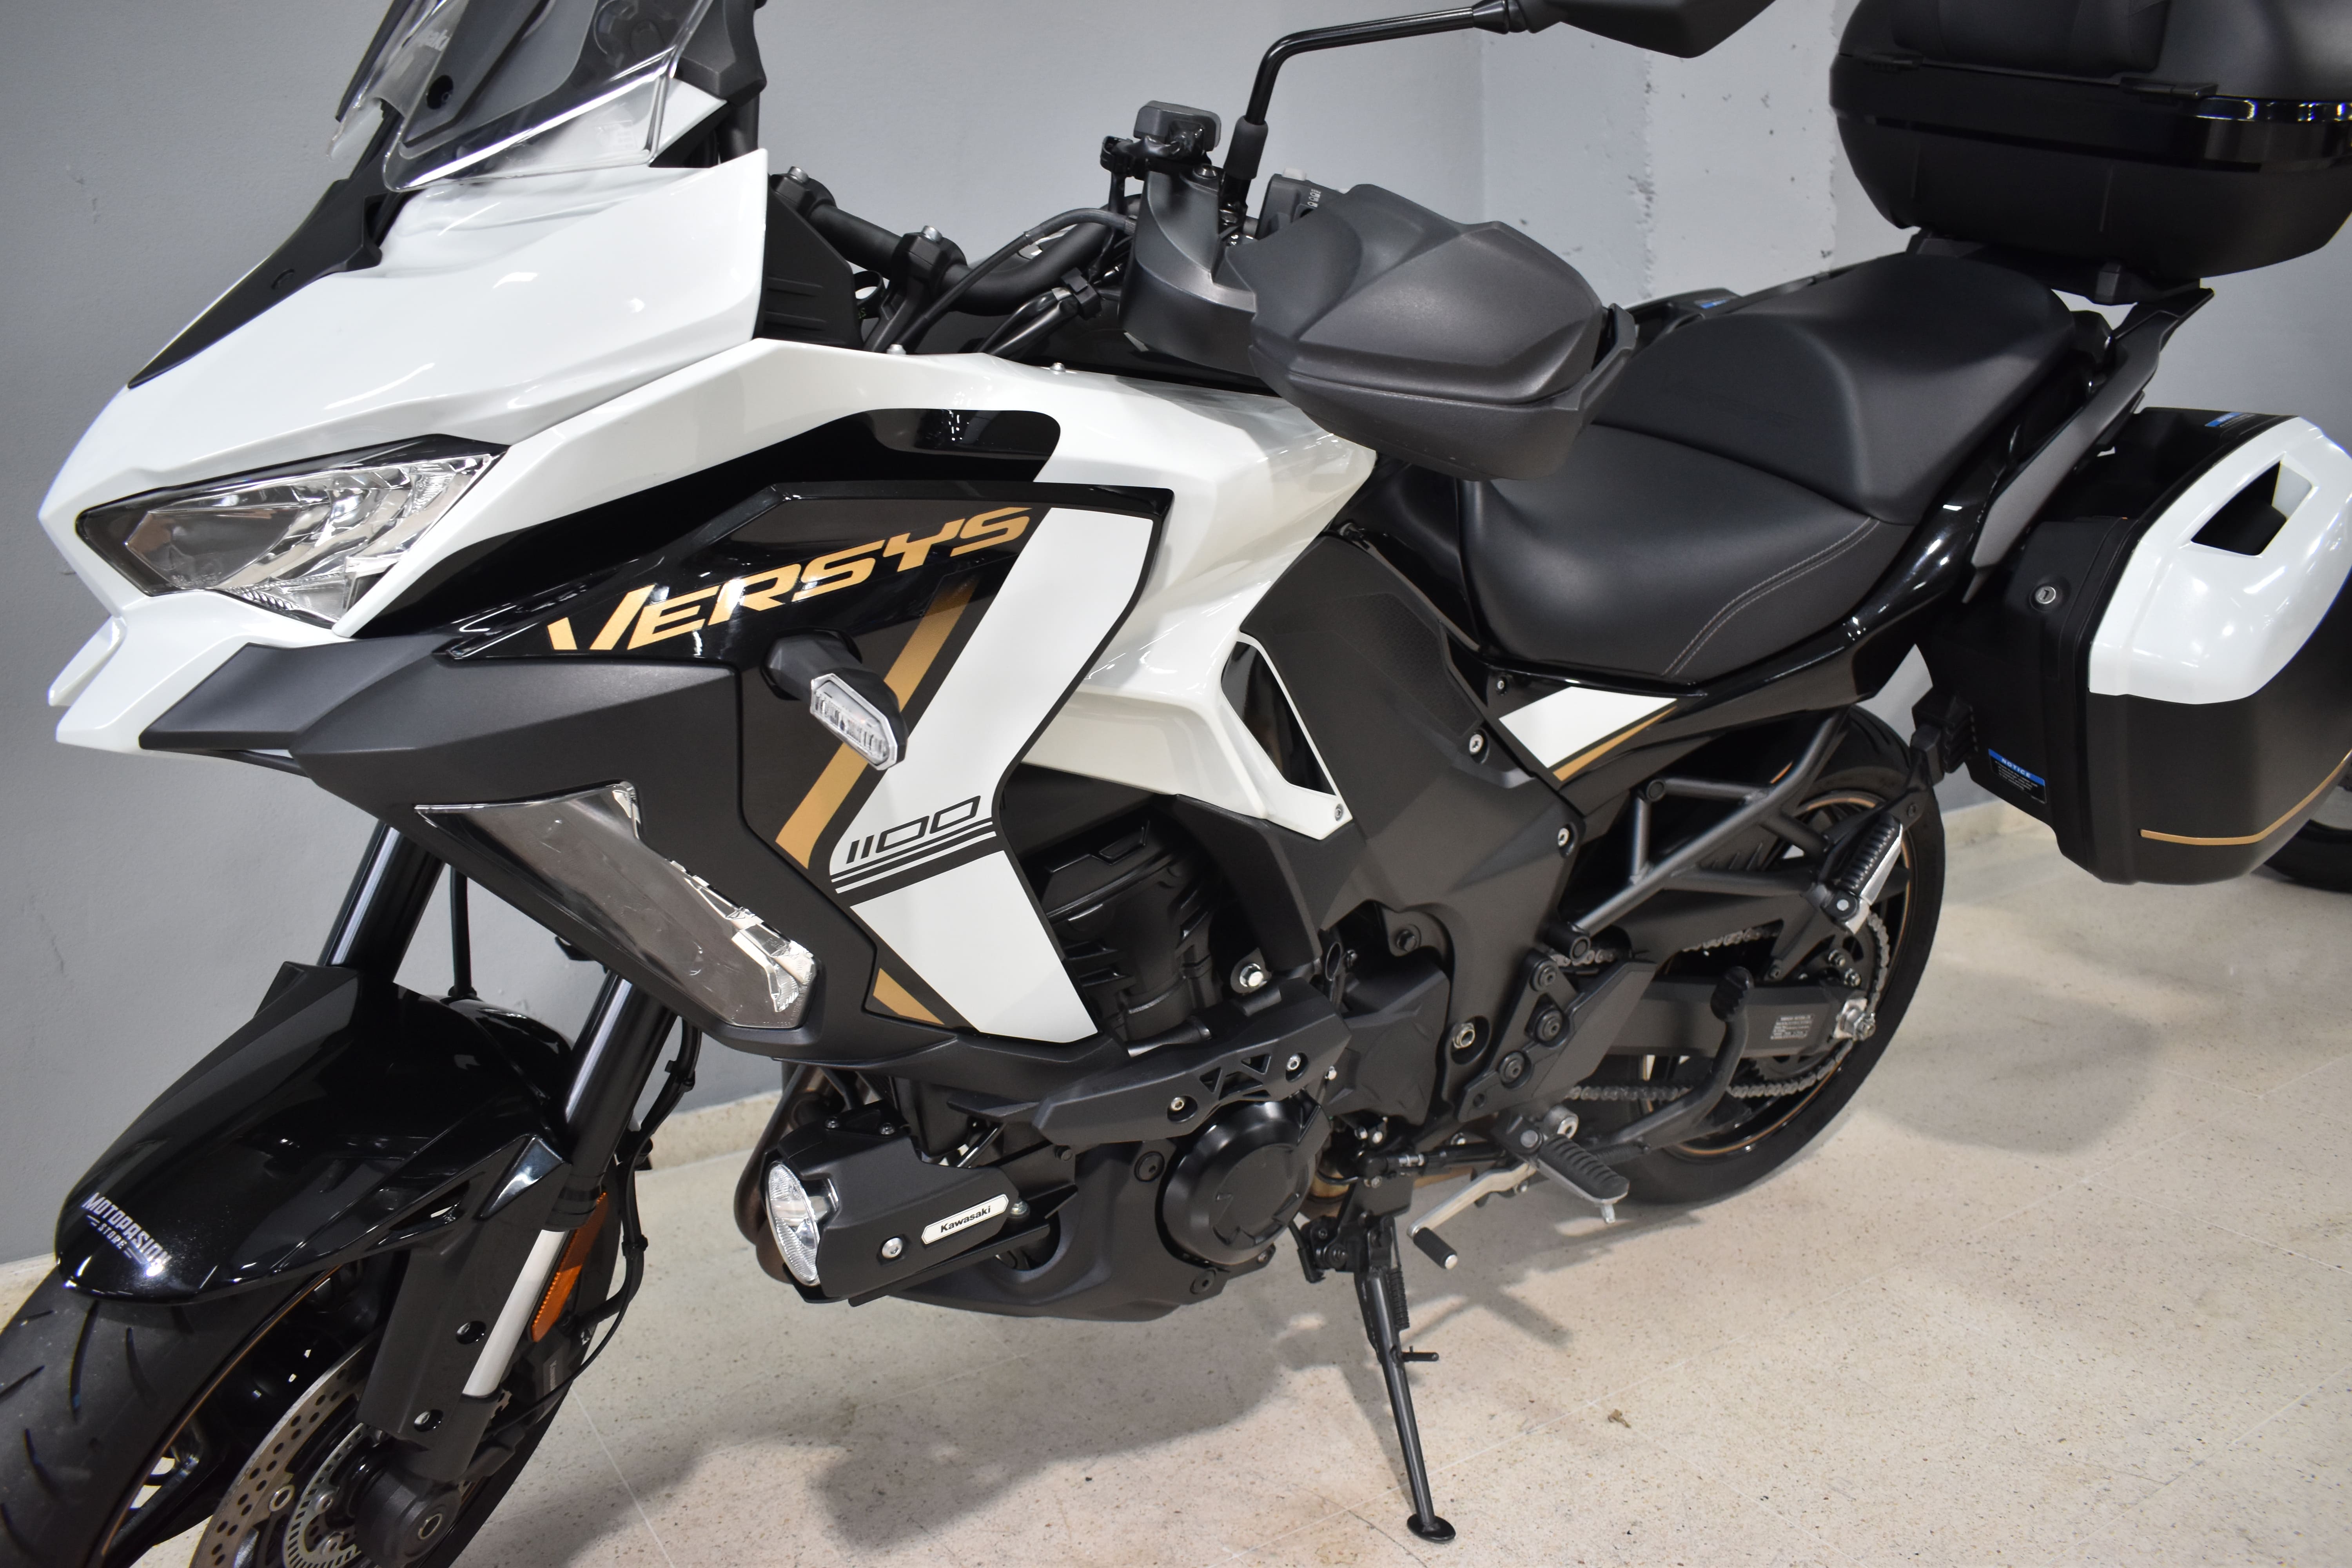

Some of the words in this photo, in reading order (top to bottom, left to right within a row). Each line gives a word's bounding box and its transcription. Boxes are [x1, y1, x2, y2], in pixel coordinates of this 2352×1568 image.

[547, 507, 1032, 650] VERSYS
[2001, 758, 2031, 778] NOTICE
[846, 795, 981, 864] 1100
[82, 1192, 172, 1267] MOTOPASION
[98, 1223, 127, 1249] STORE
[941, 1205, 991, 1232] Kawasaki
